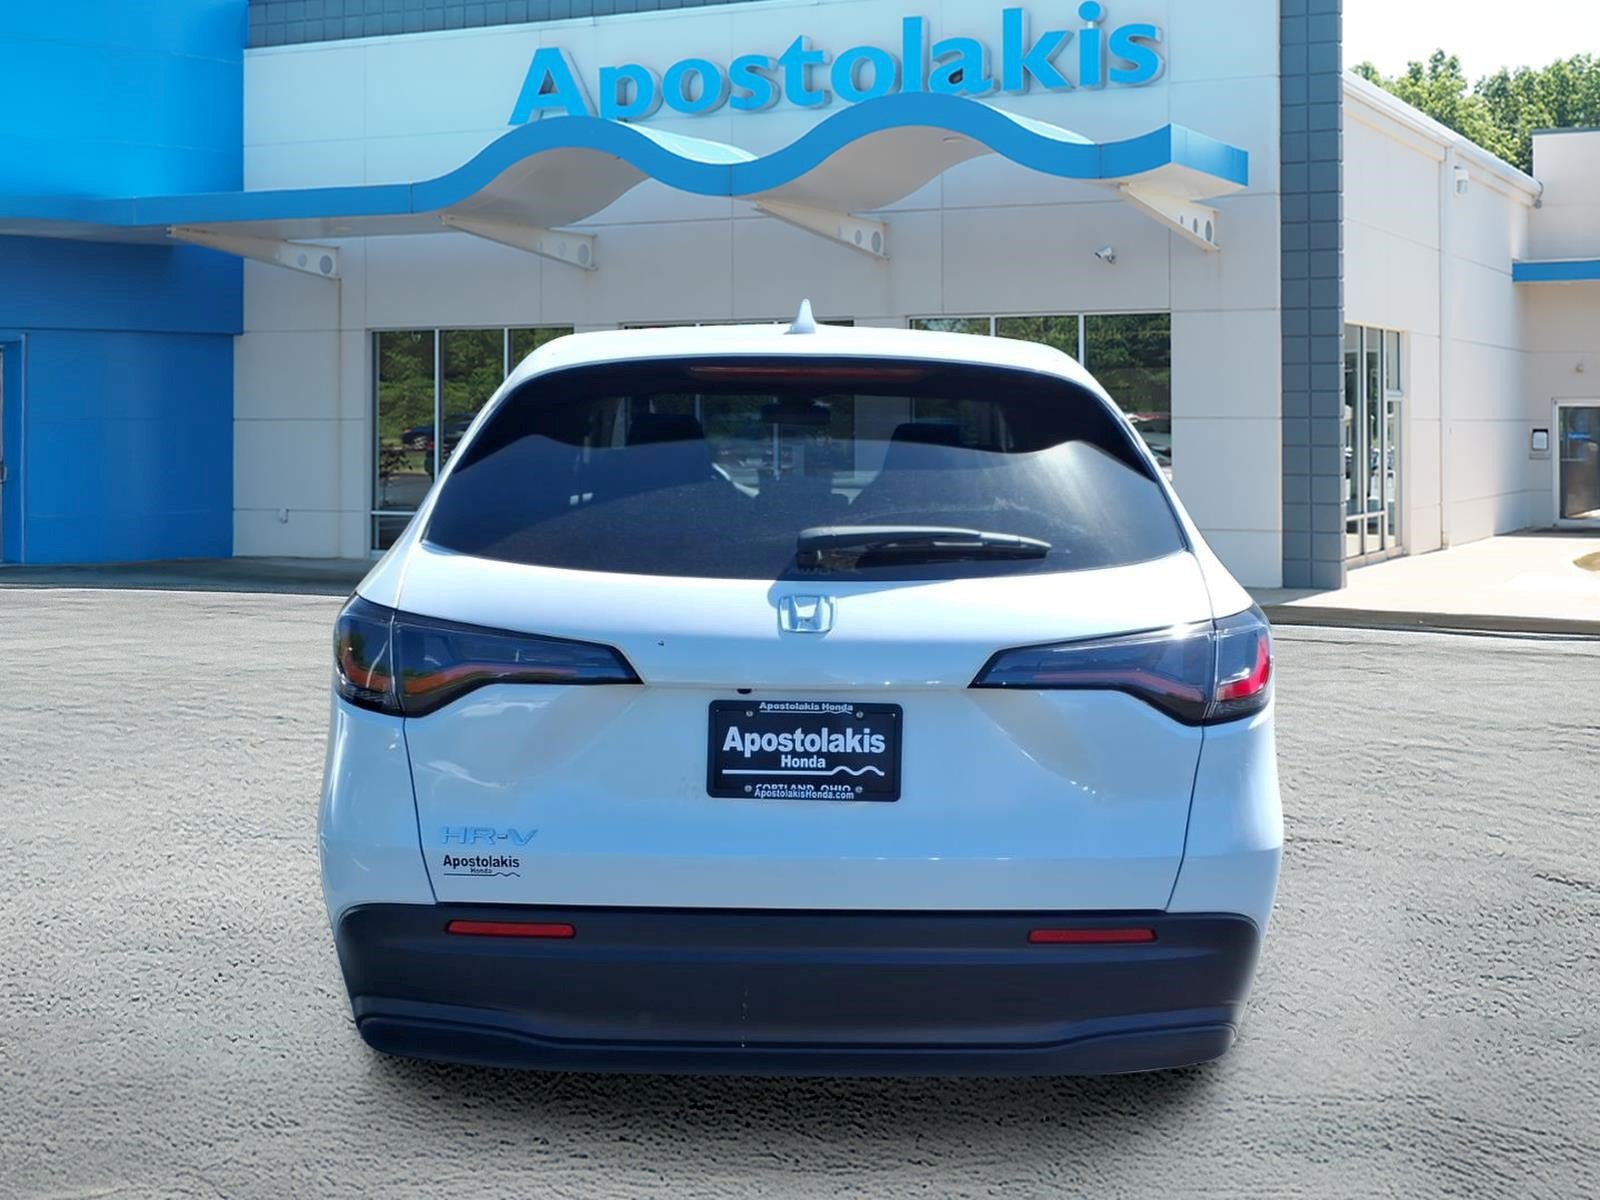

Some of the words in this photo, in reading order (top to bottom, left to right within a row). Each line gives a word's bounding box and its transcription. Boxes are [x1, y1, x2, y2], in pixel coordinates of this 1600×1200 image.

[508, 1, 1162, 125] Apostolakis
[759, 702, 820, 711] Apostolakis
[821, 703, 854, 711] Honda
[722, 726, 886, 758] Apostolakis
[780, 755, 826, 769] Honda
[754, 788, 854, 799] ApostolakisHonda.com
[440, 826, 538, 846] HR-V
[443, 854, 520, 869] Apostolakis
